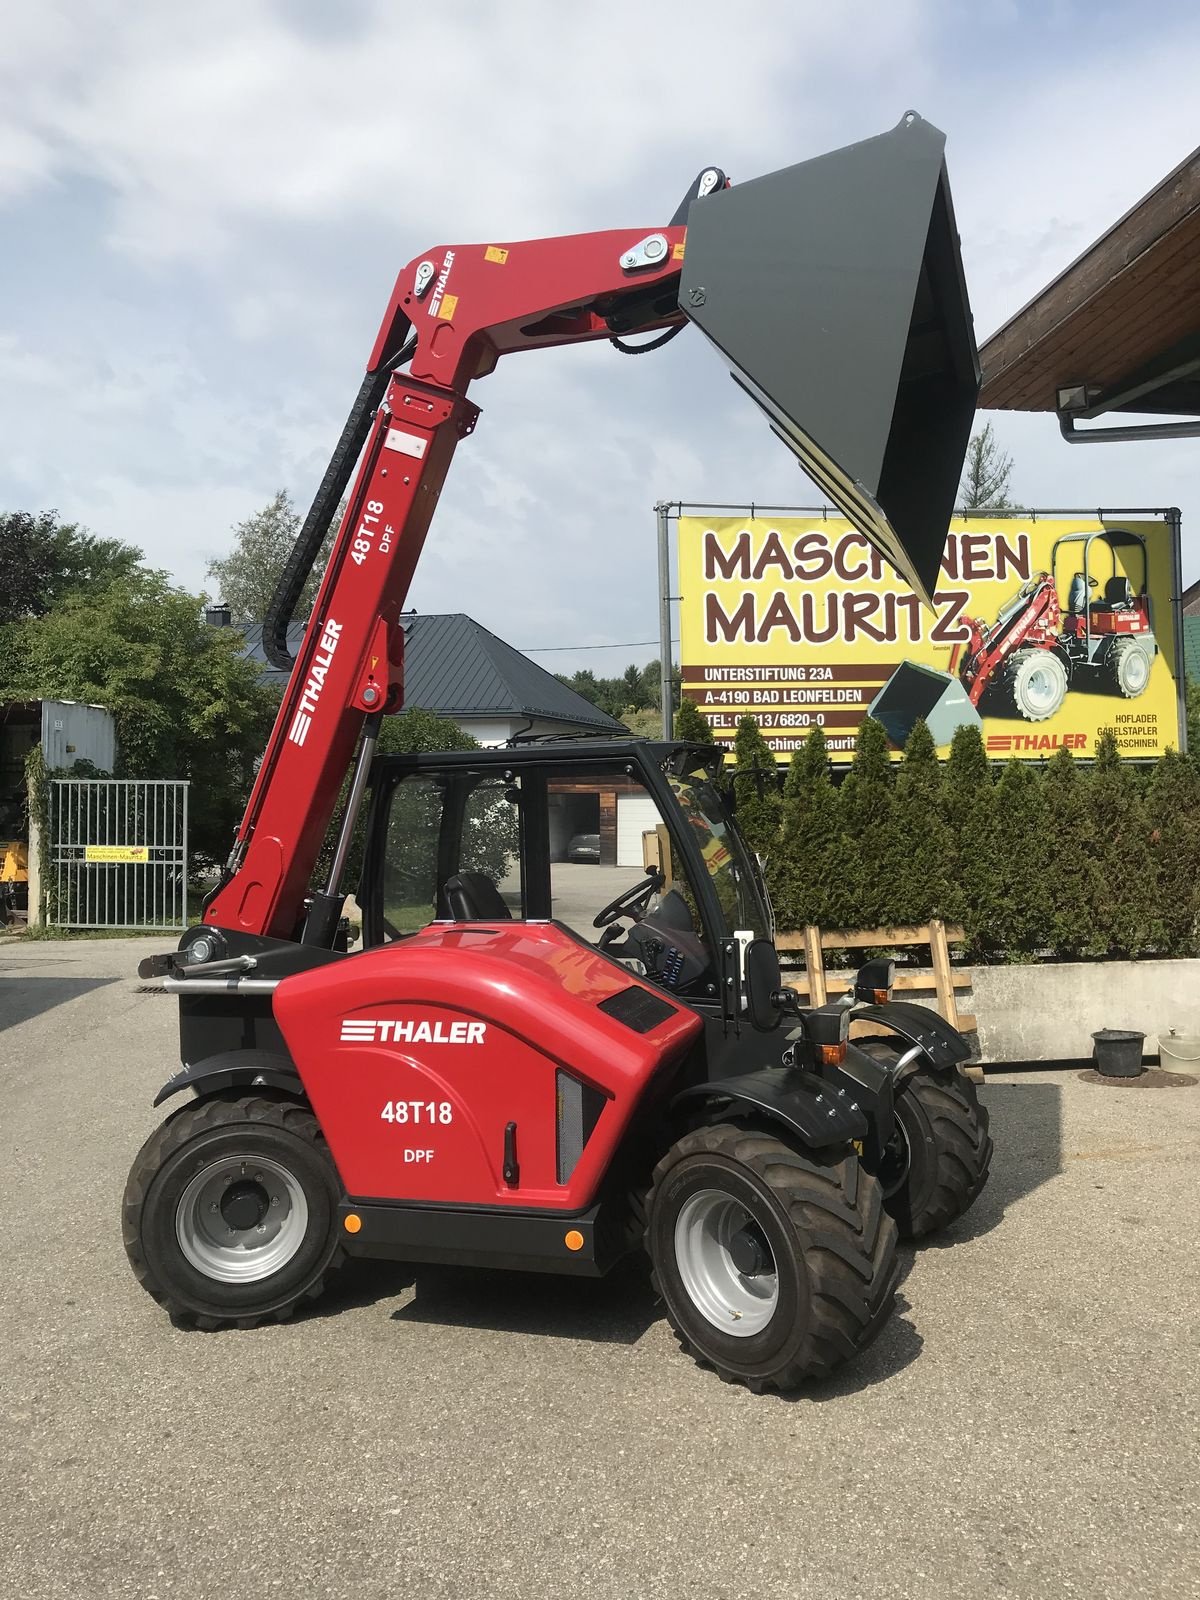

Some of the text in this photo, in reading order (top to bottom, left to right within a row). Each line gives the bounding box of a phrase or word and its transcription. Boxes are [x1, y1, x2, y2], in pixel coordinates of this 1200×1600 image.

[433, 250, 456, 299] THALER
[350, 500, 385, 565] 48T18
[379, 524, 396, 554] DPF
[705, 532, 1030, 580] MASCNEN
[706, 591, 970, 643] MAURITZ
[300, 618, 343, 713] THALER
[704, 667, 834, 681] UNTERSTIFTUNG 23A
[705, 689, 862, 704] A-4190 BAD LEONFELDEN
[705, 713, 825, 727] TEL: 013/6820-0
[1115, 714, 1158, 724] HOFLADER
[1011, 733, 1088, 750] THALER
[1097, 727, 1158, 736] GABELSTAPLER
[1094, 739, 1158, 748] BASCHINEN
[375, 1020, 487, 1044] THALER
[380, 1101, 453, 1124] 48T18
[403, 1149, 435, 1163] DPF
